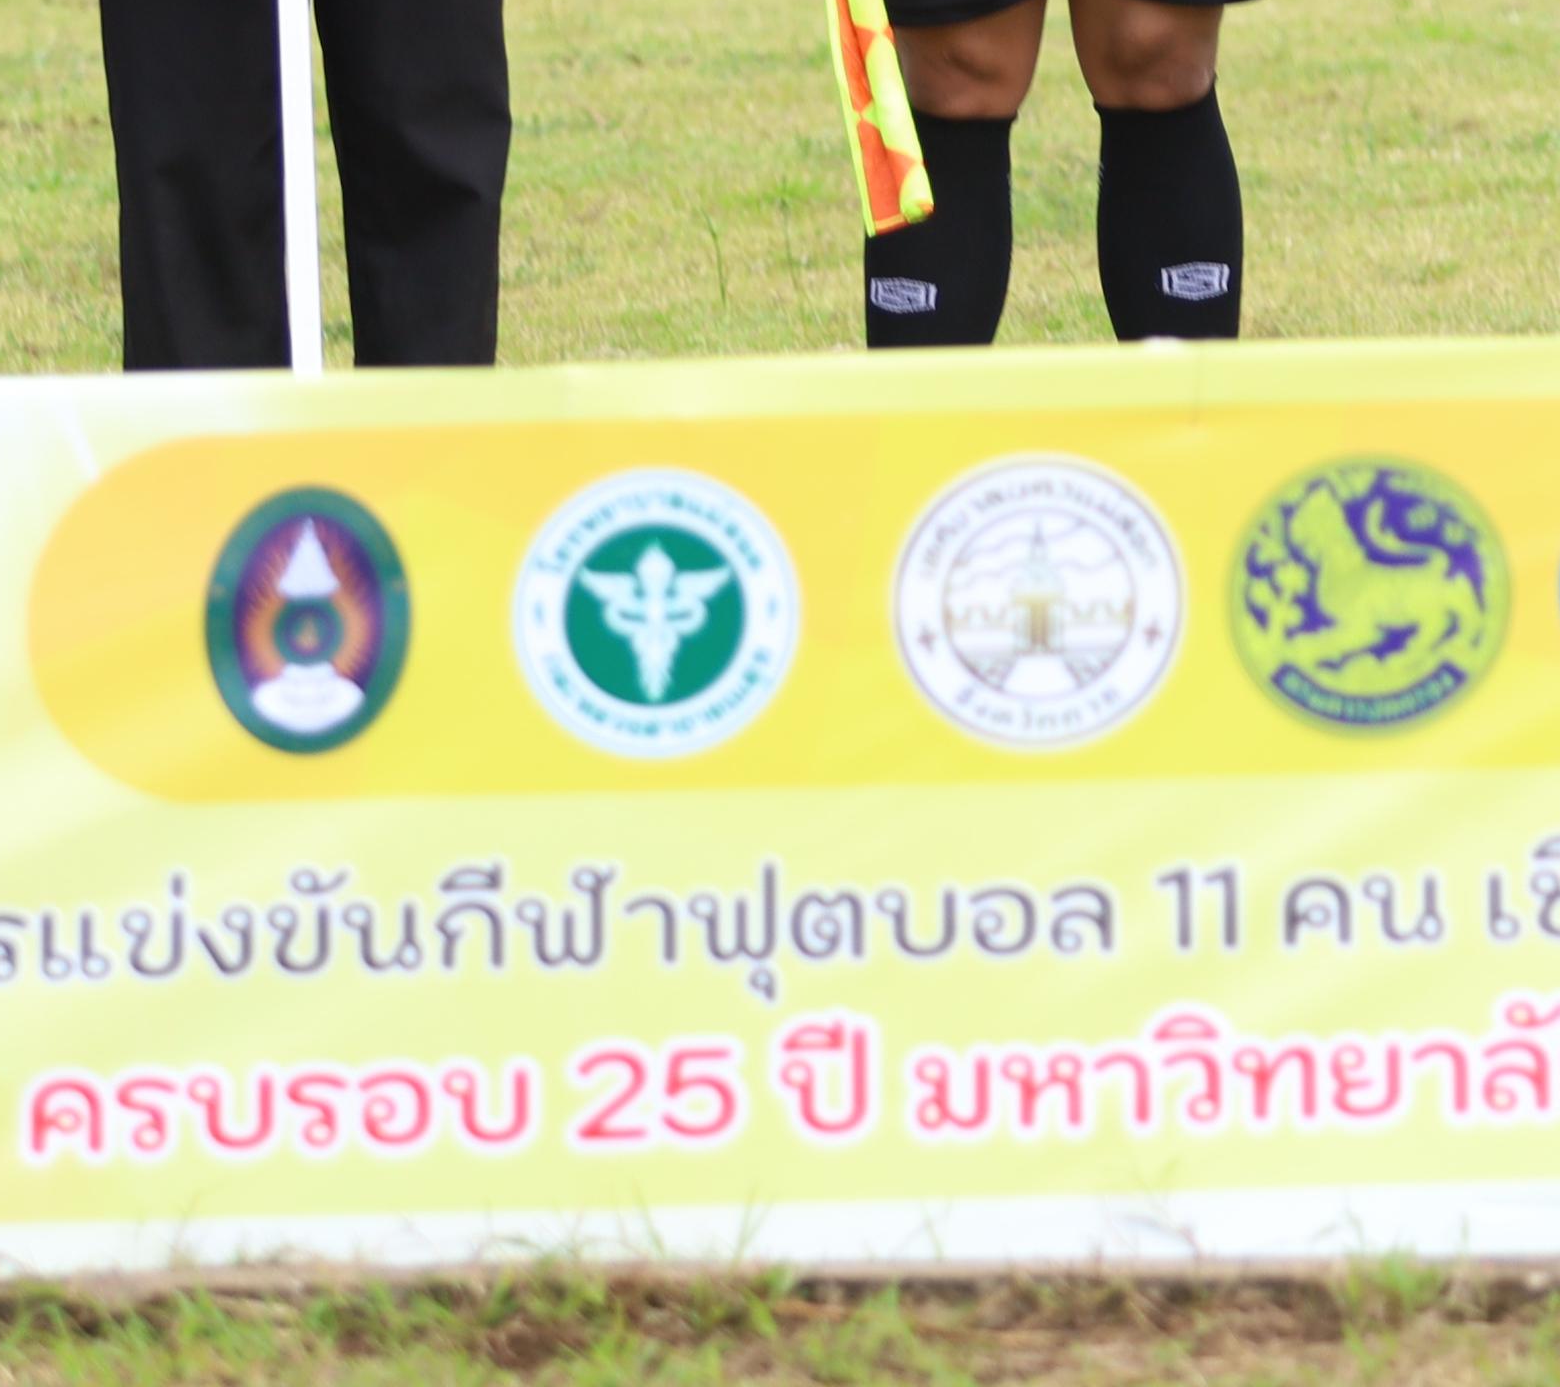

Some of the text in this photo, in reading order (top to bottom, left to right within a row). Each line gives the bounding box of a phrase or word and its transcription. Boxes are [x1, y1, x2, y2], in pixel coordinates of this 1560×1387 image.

[1156, 868, 1240, 950] 11
[1282, 873, 1445, 947] คน
[31, 1065, 530, 1154] ครบรอบ
[576, 1048, 738, 1143] 25
[780, 1019, 871, 1136] ปี
